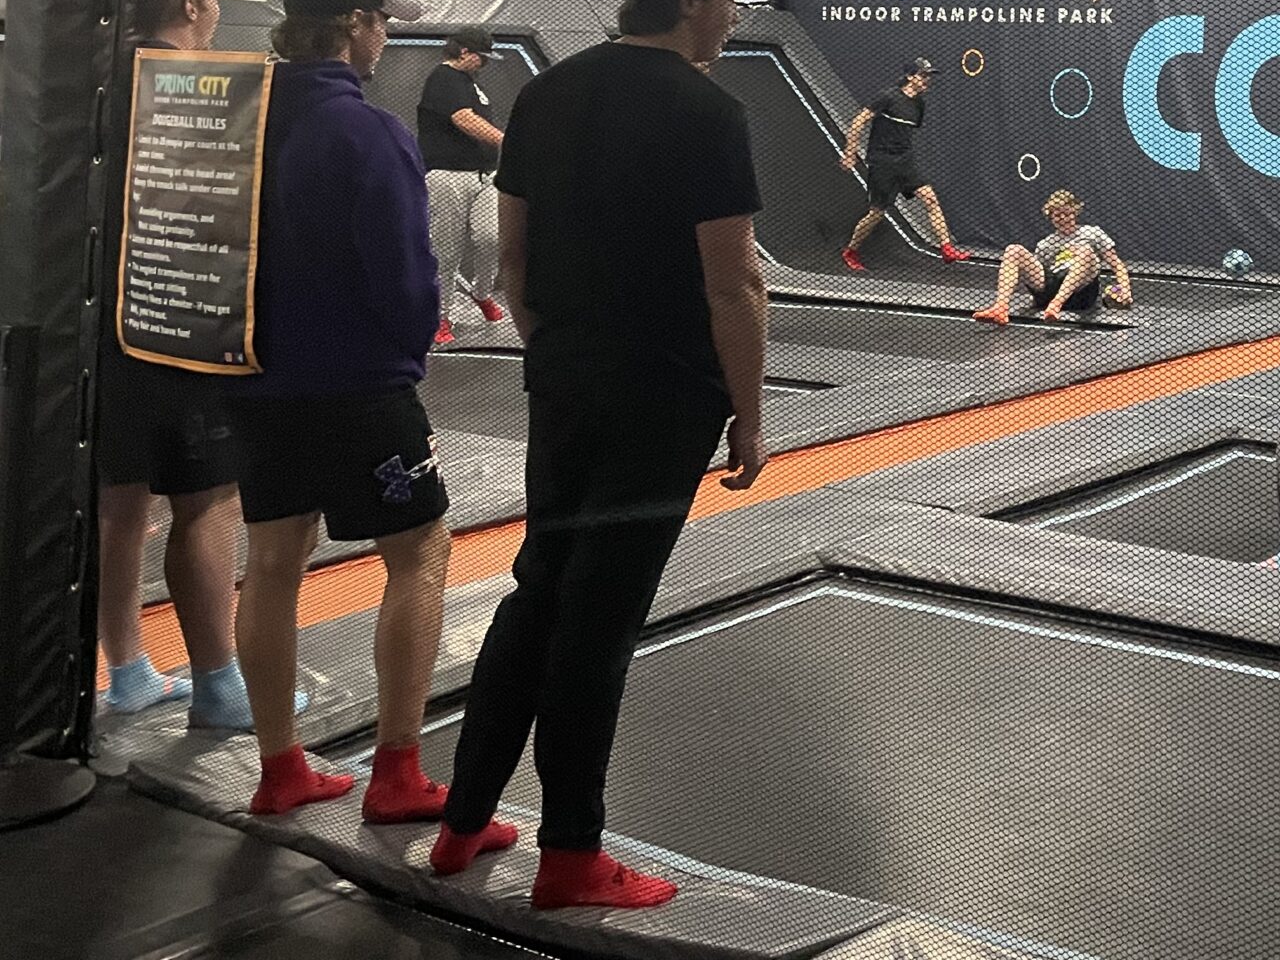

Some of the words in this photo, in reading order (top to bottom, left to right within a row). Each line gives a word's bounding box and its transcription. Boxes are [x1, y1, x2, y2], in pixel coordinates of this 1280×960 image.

[822, 6, 901, 22] INDOOR
[911, 6, 1046, 23] TRAMPOLINE
[1057, 7, 1114, 24] PARK
[154, 73, 196, 95] SPRING
[199, 75, 231, 98] CITY
[210, 99, 230, 108] PARK
[152, 113, 195, 128] DODGEBALL
[196, 116, 227, 130] RULES
